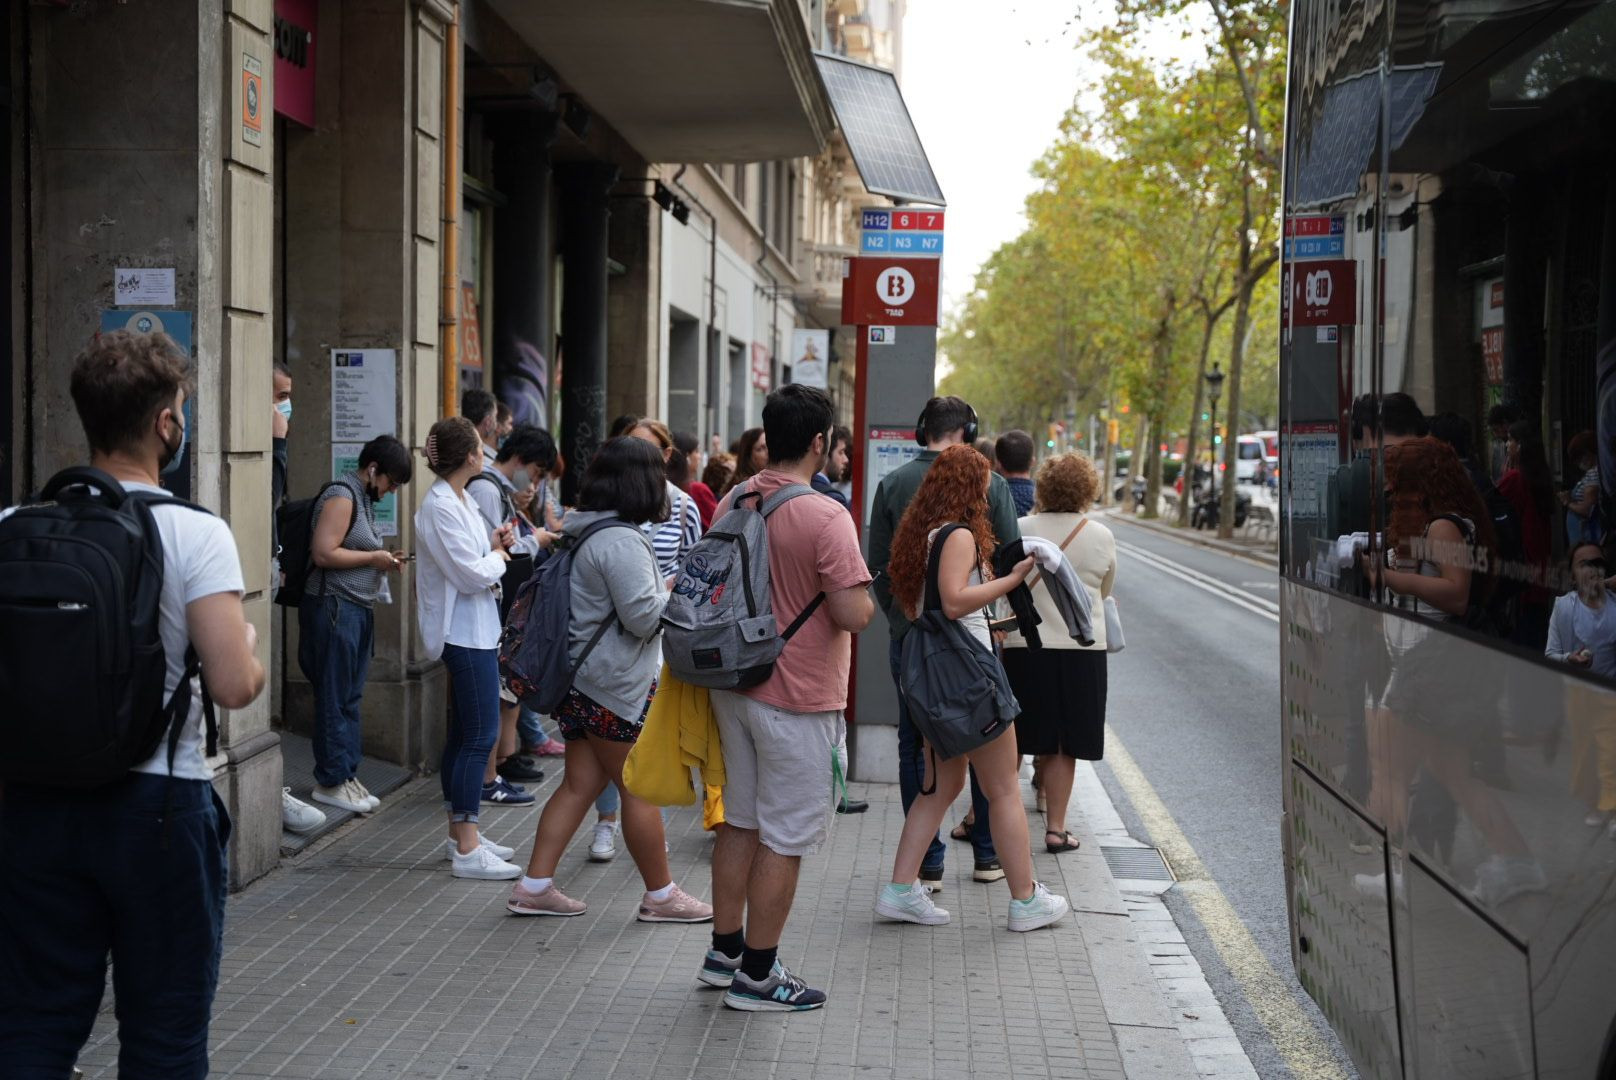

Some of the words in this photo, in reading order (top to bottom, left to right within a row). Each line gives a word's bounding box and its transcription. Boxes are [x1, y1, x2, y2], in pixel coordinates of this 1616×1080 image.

[864, 214, 888, 226] H12
[900, 214, 909, 226] 6
[927, 215, 936, 227] 7
[867, 236, 884, 248] N2
[895, 236, 912, 248] N3
[922, 238, 938, 249] N7
[887, 275, 905, 297] B
[491, 790, 508, 802] N
[772, 985, 791, 1002] N
